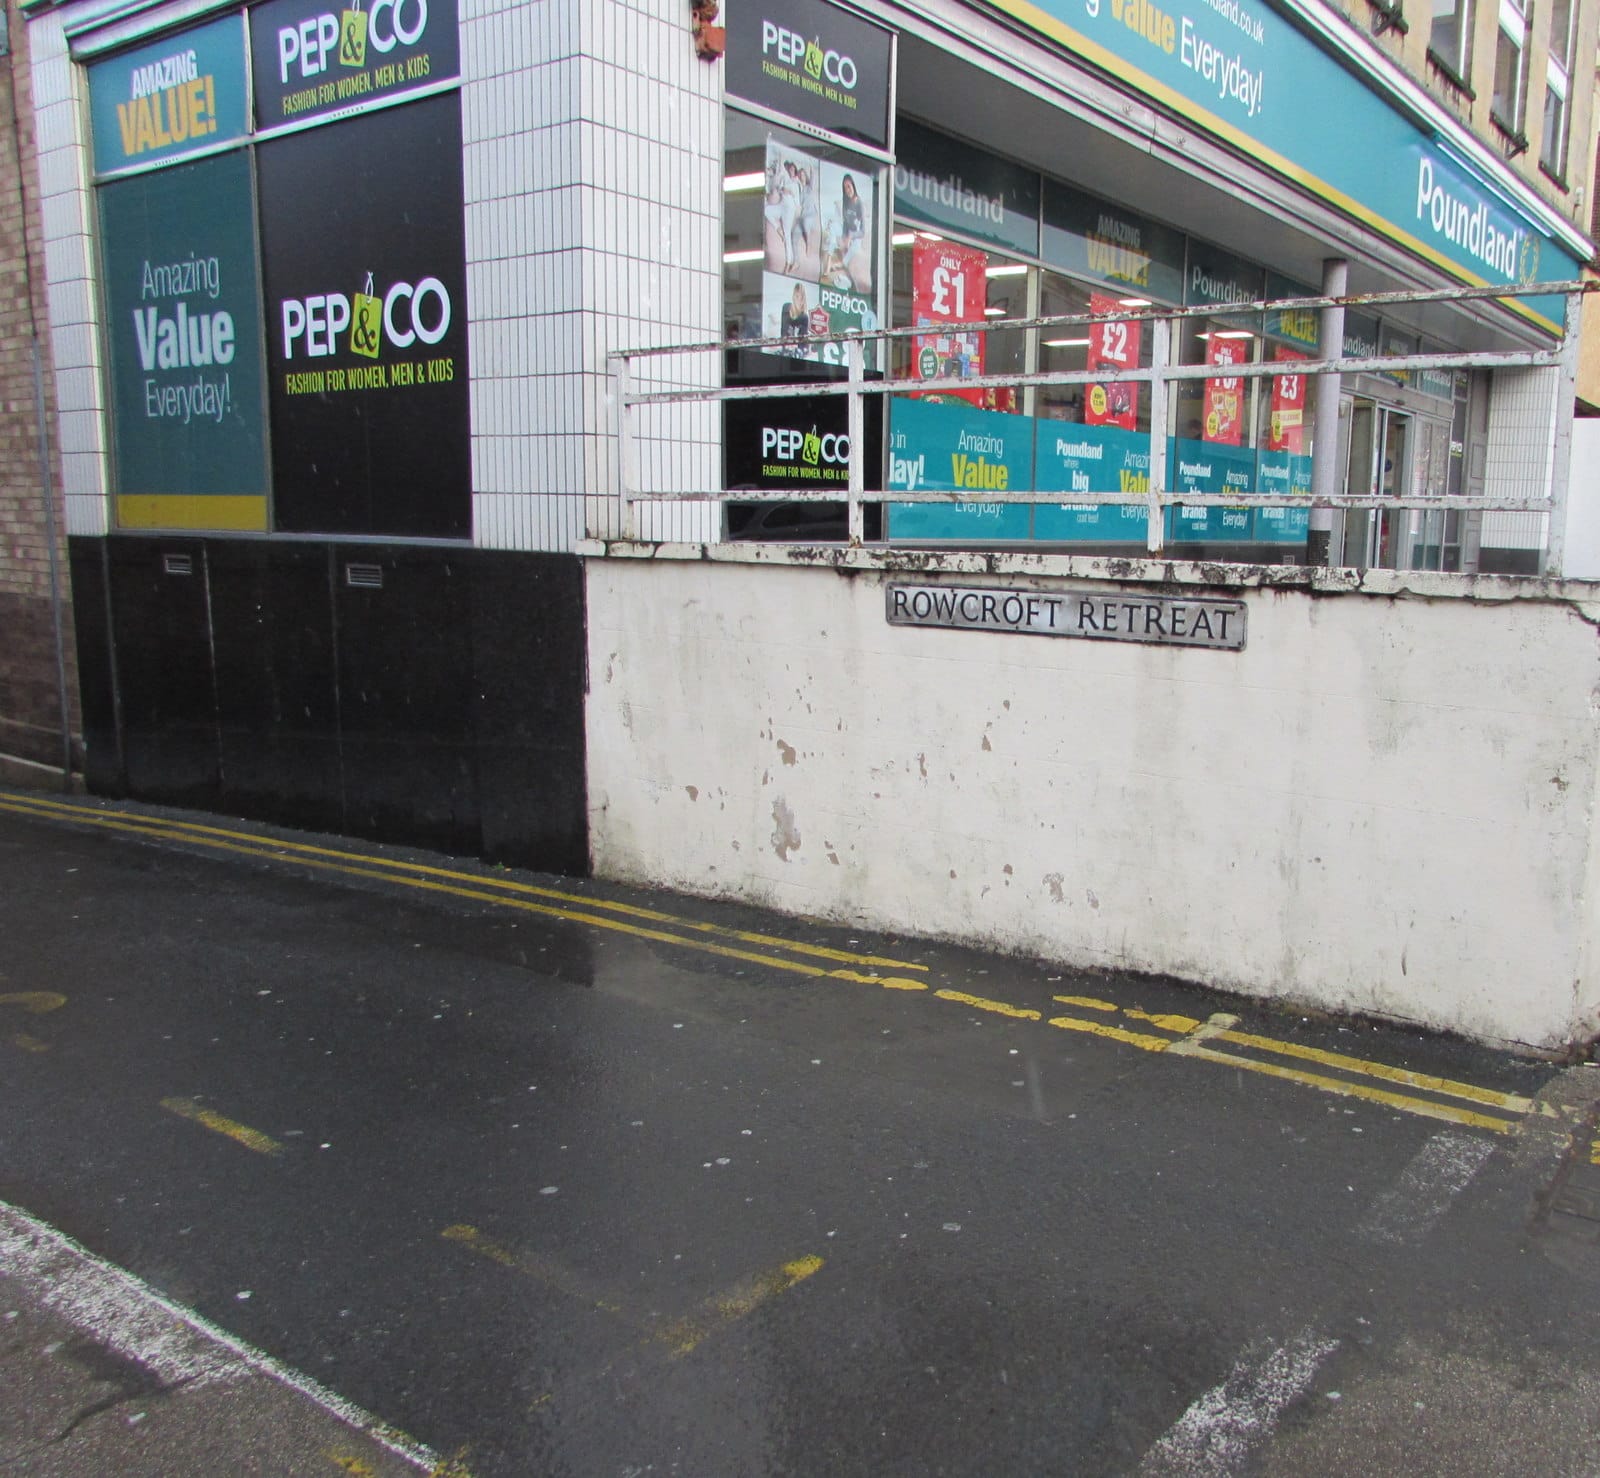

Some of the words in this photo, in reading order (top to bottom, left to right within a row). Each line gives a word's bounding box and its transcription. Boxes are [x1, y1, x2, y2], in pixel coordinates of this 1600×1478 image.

[132, 49, 198, 100] AMAZING
[762, 60, 788, 82] FASHION
[788, 71, 801, 88] FOR
[825, 86, 838, 102] MEN
[1180, 15, 1263, 117] Everyday!
[283, 88, 317, 116] FASHION
[319, 82, 336, 105] FOR
[375, 63, 396, 89] MEN
[398, 63, 405, 82] &
[407, 54, 430, 80] KIDS
[116, 74, 217, 156] VALUE!
[894, 163, 1004, 225] oundland
[1097, 213, 1141, 249] AMAZING
[1416, 156, 1518, 280] Poundland
[142, 251, 220, 301] Amazing
[940, 256, 962, 271] ONLY
[1085, 229, 1150, 288] VALUE!
[931, 266, 965, 319] £1
[133, 302, 236, 371] Value
[1101, 321, 1128, 362] £2
[1342, 334, 1377, 360] undland
[286, 373, 325, 395] FASHION
[327, 369, 346, 391] FOR
[391, 362, 415, 386] MEN
[417, 363, 425, 384] &
[427, 358, 454, 382] KIDS
[1281, 375, 1299, 401] £3
[145, 372, 232, 425] Everyday!
[958, 429, 1004, 459] Amazing
[1056, 439, 1103, 460] Poundland
[1124, 450, 1150, 469] Amazi
[762, 465, 787, 477] FASHION
[787, 466, 799, 478] FOR
[823, 469, 835, 480] MEN
[951, 453, 1009, 490] Value
[1072, 470, 1090, 492] big
[1120, 469, 1150, 493] Valu
[1179, 461, 1212, 478] Poundland
[1226, 469, 1249, 489] Amazing
[1260, 463, 1290, 480] Poundland
[1121, 505, 1150, 522] Everyda
[1222, 511, 1248, 530] Everyday!
[893, 590, 1062, 628] ROWCROFT
[1077, 602, 1236, 640] RETREAT
